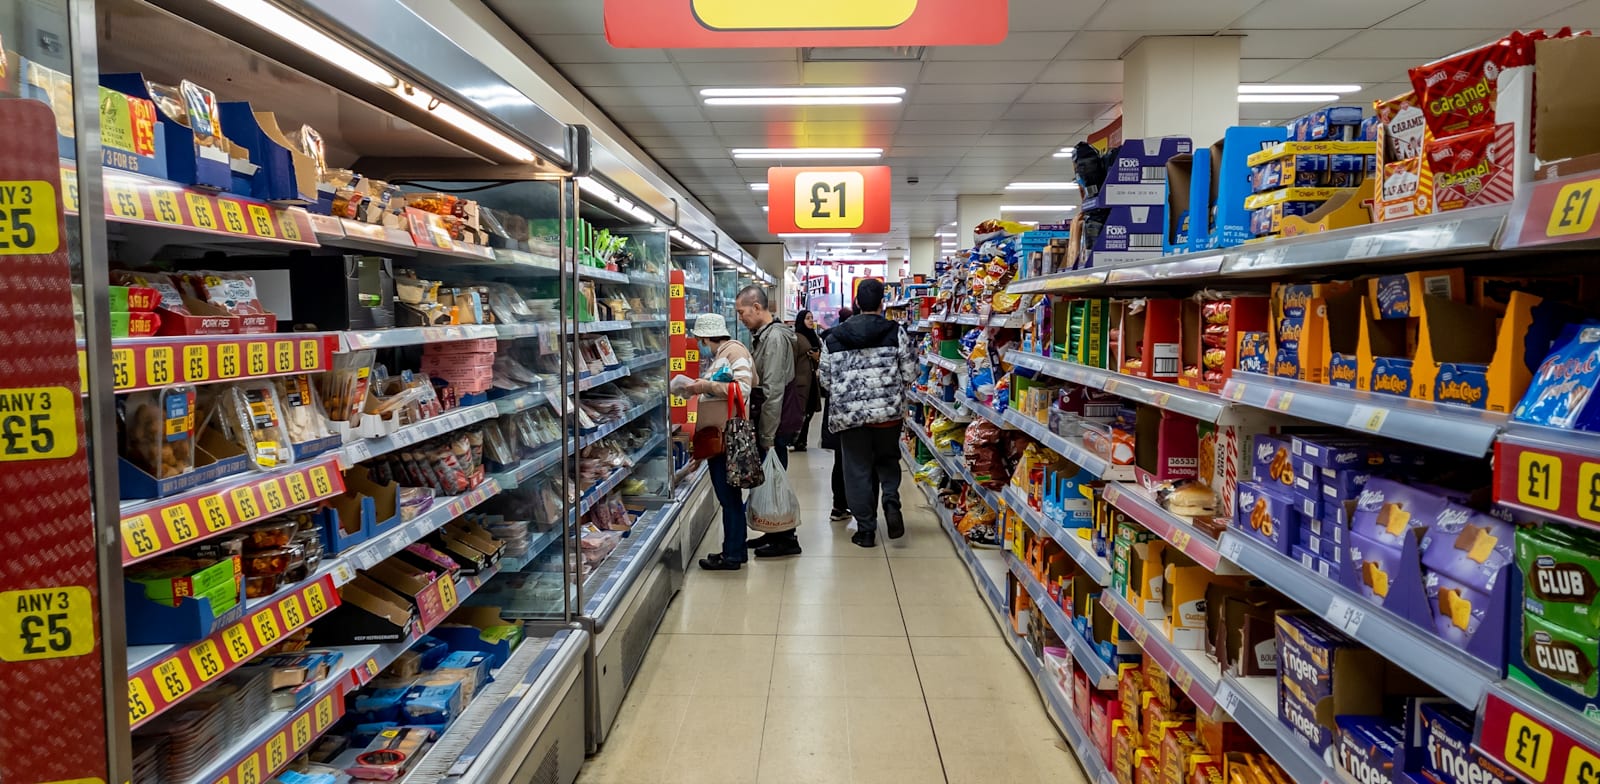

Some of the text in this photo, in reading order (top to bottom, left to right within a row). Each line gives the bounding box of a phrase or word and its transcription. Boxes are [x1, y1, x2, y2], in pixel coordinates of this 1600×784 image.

[1430, 77, 1491, 116] Caramel
[1467, 102, 1484, 116] LOG
[107, 152, 113, 165] 3
[113, 154, 127, 169] FOR
[129, 156, 138, 171] £5
[1438, 158, 1490, 190] Caramel
[22, 187, 32, 204] 3
[117, 192, 137, 217] £5
[810, 182, 846, 218] £1
[159, 200, 176, 222] £5
[195, 206, 211, 227] £5
[1558, 188, 1592, 228] £1
[228, 211, 242, 231] £5
[256, 216, 271, 235] £5
[202, 319, 230, 328] PORK PIES
[243, 317, 266, 326] PORK PIES
[190, 358, 203, 379] £5
[223, 356, 235, 376] £5
[252, 354, 264, 373] £5
[280, 352, 290, 370] £5
[304, 350, 314, 367] £5
[113, 363, 128, 387] £5
[153, 360, 168, 382] £5
[1374, 374, 1407, 394] Jaffa Cakes
[1439, 381, 1482, 403] Jaffa Cakes
[0, 392, 52, 412] ANY 3
[2, 414, 54, 455] £5
[316, 476, 328, 494] £5
[1528, 460, 1550, 500] £1
[267, 490, 281, 509] £5
[293, 483, 306, 502] £5
[1358, 489, 1384, 504] Milka
[209, 507, 226, 529] £5
[240, 497, 255, 519] £5
[1436, 508, 1470, 526] Milka
[173, 517, 192, 541] £5
[132, 528, 153, 554] £5
[1538, 570, 1584, 596] CLUB
[17, 592, 69, 613] ANY 3
[311, 594, 323, 613] £5
[286, 607, 300, 627] £5
[20, 613, 72, 654] £5
[261, 621, 276, 641] £5
[232, 636, 248, 658] £5
[201, 654, 218, 677] £5
[1283, 646, 1318, 686] fingers
[1535, 644, 1580, 674] CLUB
[161, 664, 169, 676] ANY
[164, 673, 184, 698] £5
[128, 694, 147, 720] £5
[319, 709, 330, 728] £5
[297, 728, 308, 748] £5
[1516, 726, 1541, 769] £1
[272, 747, 282, 768] £5
